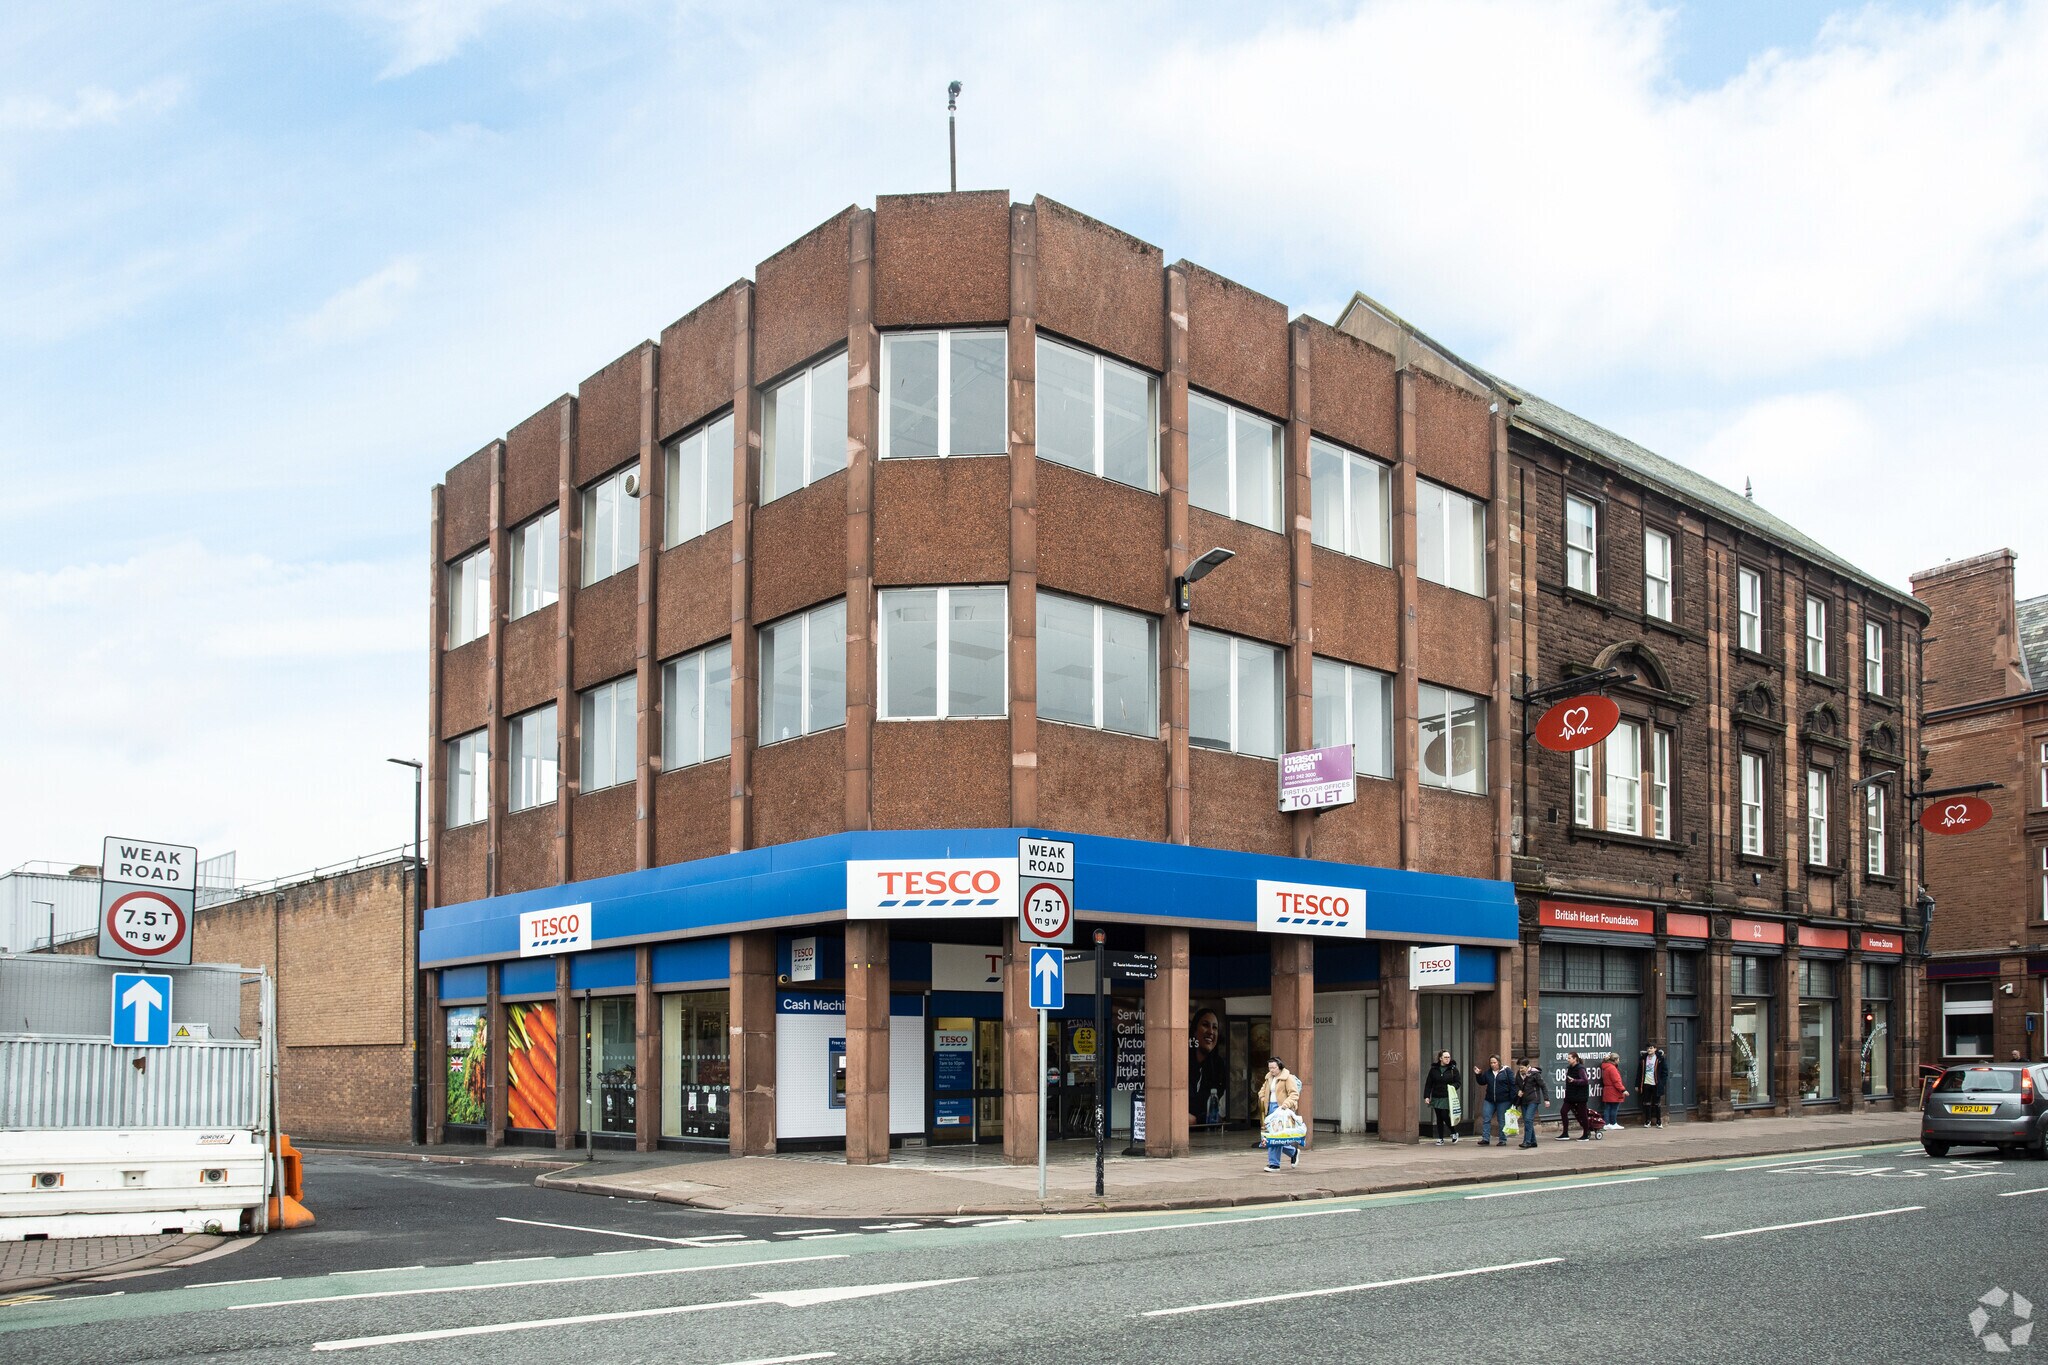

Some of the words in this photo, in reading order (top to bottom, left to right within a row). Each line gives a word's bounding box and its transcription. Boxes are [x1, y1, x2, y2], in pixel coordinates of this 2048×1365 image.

[1284, 752, 1322, 766] mason
[1284, 762, 1316, 773] owen
[1302, 785, 1323, 793] FLOOR
[1324, 781, 1351, 791] OFFICES
[1291, 794, 1311, 807] TO
[1316, 789, 1342, 804] LET
[120, 845, 181, 865] WEAK
[1028, 844, 1065, 859] WEAK
[120, 863, 179, 881] ROAD
[1029, 860, 1065, 873] ROAD
[877, 870, 1001, 895] TESCO
[1276, 892, 1350, 917] TESCO
[1555, 909, 1579, 921] British
[1580, 911, 1599, 923] Heart
[1601, 913, 1639, 926] Foundation
[531, 914, 579, 938] TESCO
[1869, 938, 1882, 947] Home
[1882, 939, 1893, 948] Store
[793, 947, 814, 958] TESCO
[1419, 959, 1451, 970] TESCO
[783, 998, 811, 1010] Cash
[451, 1016, 476, 1026] Harvested
[1313, 1016, 1333, 1024] ouse
[1556, 1013, 1580, 1028] FREE
[1581, 1013, 1588, 1028] &
[1589, 1013, 1612, 1028] FAST
[458, 1028, 474, 1037] British
[1080, 1029, 1092, 1040] £3
[1117, 1023, 1145, 1035] Carlis
[939, 1035, 968, 1043] TESCO
[1556, 1033, 1612, 1048] COLLECTION
[1117, 1052, 1145, 1065] shopp
[1117, 1066, 1139, 1077] little
